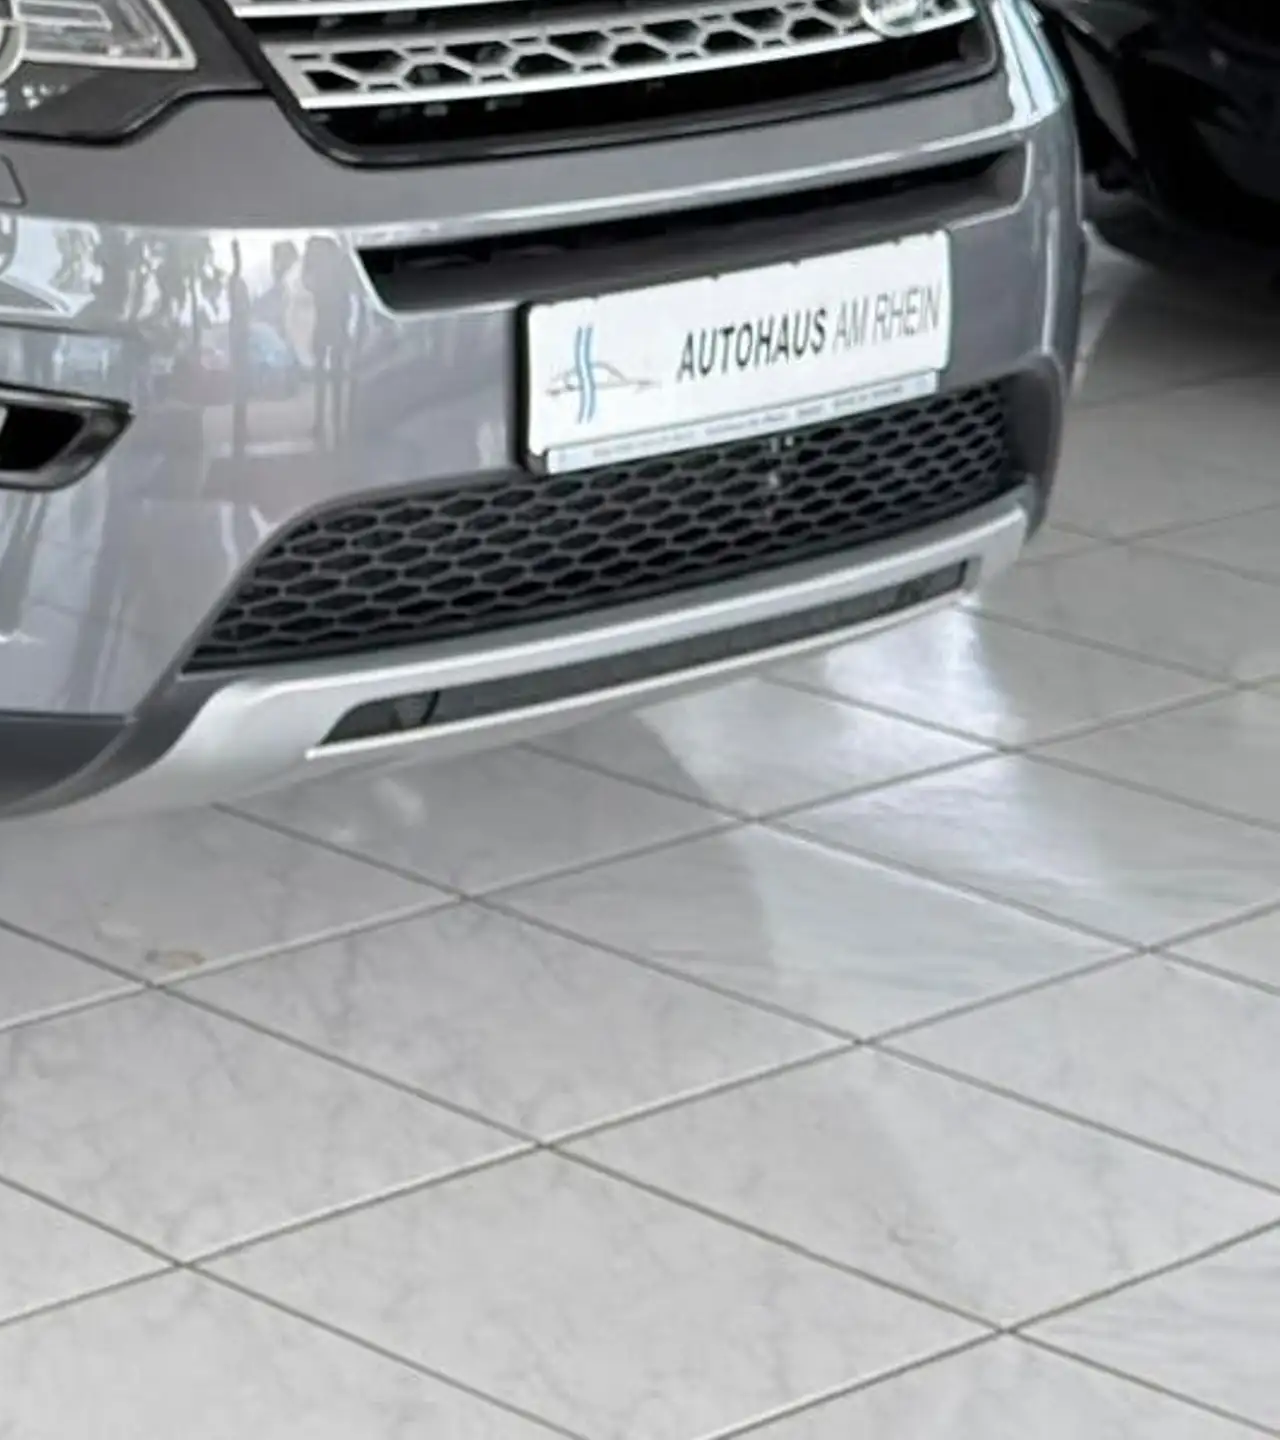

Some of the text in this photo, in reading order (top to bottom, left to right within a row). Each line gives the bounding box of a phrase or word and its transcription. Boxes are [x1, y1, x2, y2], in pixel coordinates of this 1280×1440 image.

[675, 281, 941, 383] AUTOHAUS AM RHEIN
